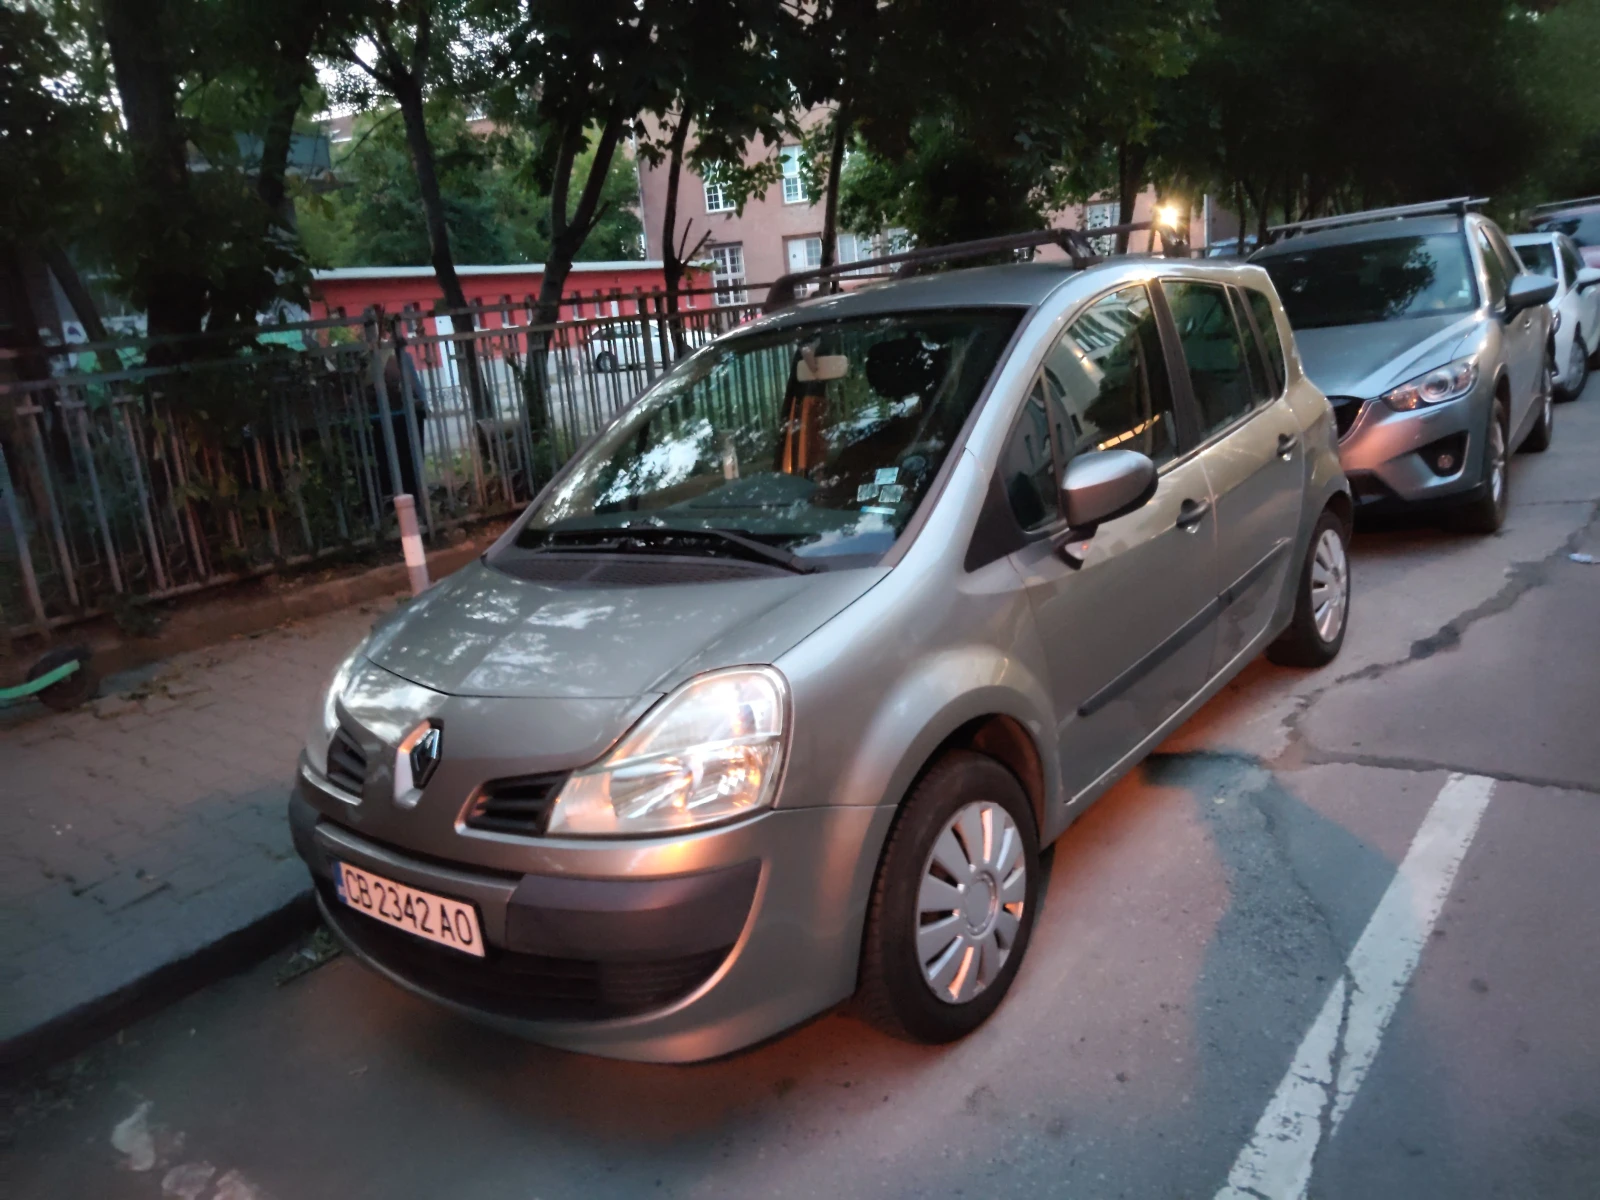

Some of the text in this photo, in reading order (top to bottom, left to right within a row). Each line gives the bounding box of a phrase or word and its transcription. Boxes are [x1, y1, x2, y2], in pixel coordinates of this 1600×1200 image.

[345, 869, 473, 946] CB 2342 AO
